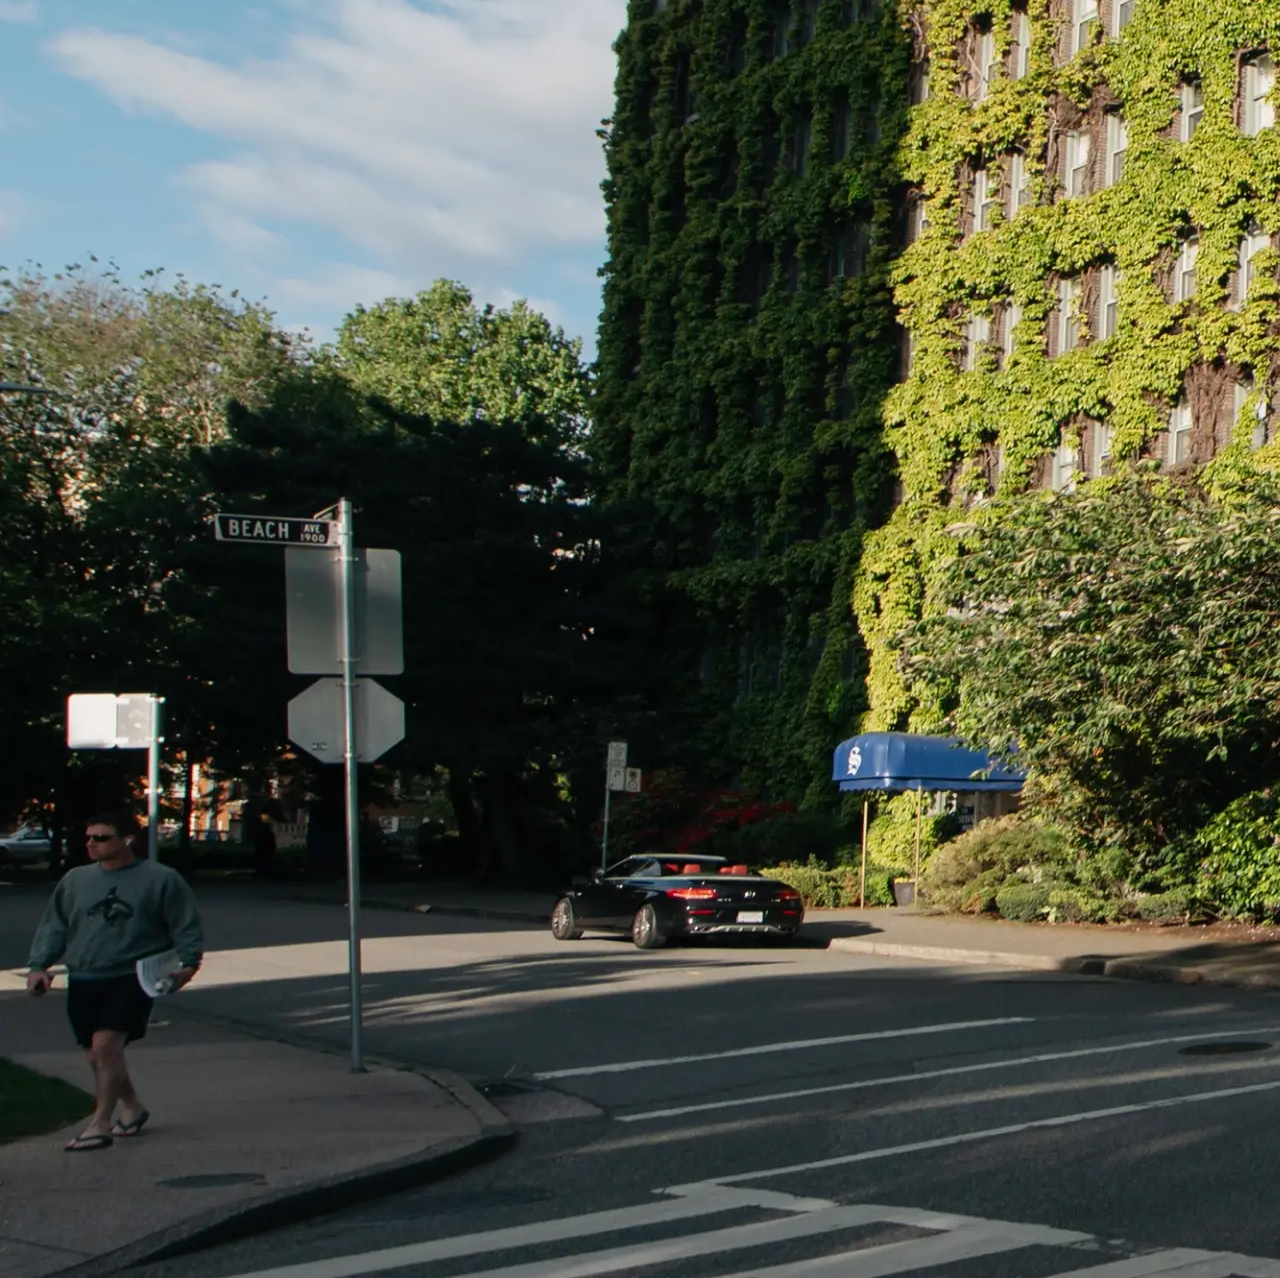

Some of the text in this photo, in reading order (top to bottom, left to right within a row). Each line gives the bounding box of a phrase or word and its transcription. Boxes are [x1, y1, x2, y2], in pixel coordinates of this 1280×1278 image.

[228, 519, 321, 539] BEACH AVE
[300, 533, 325, 542] 1900
